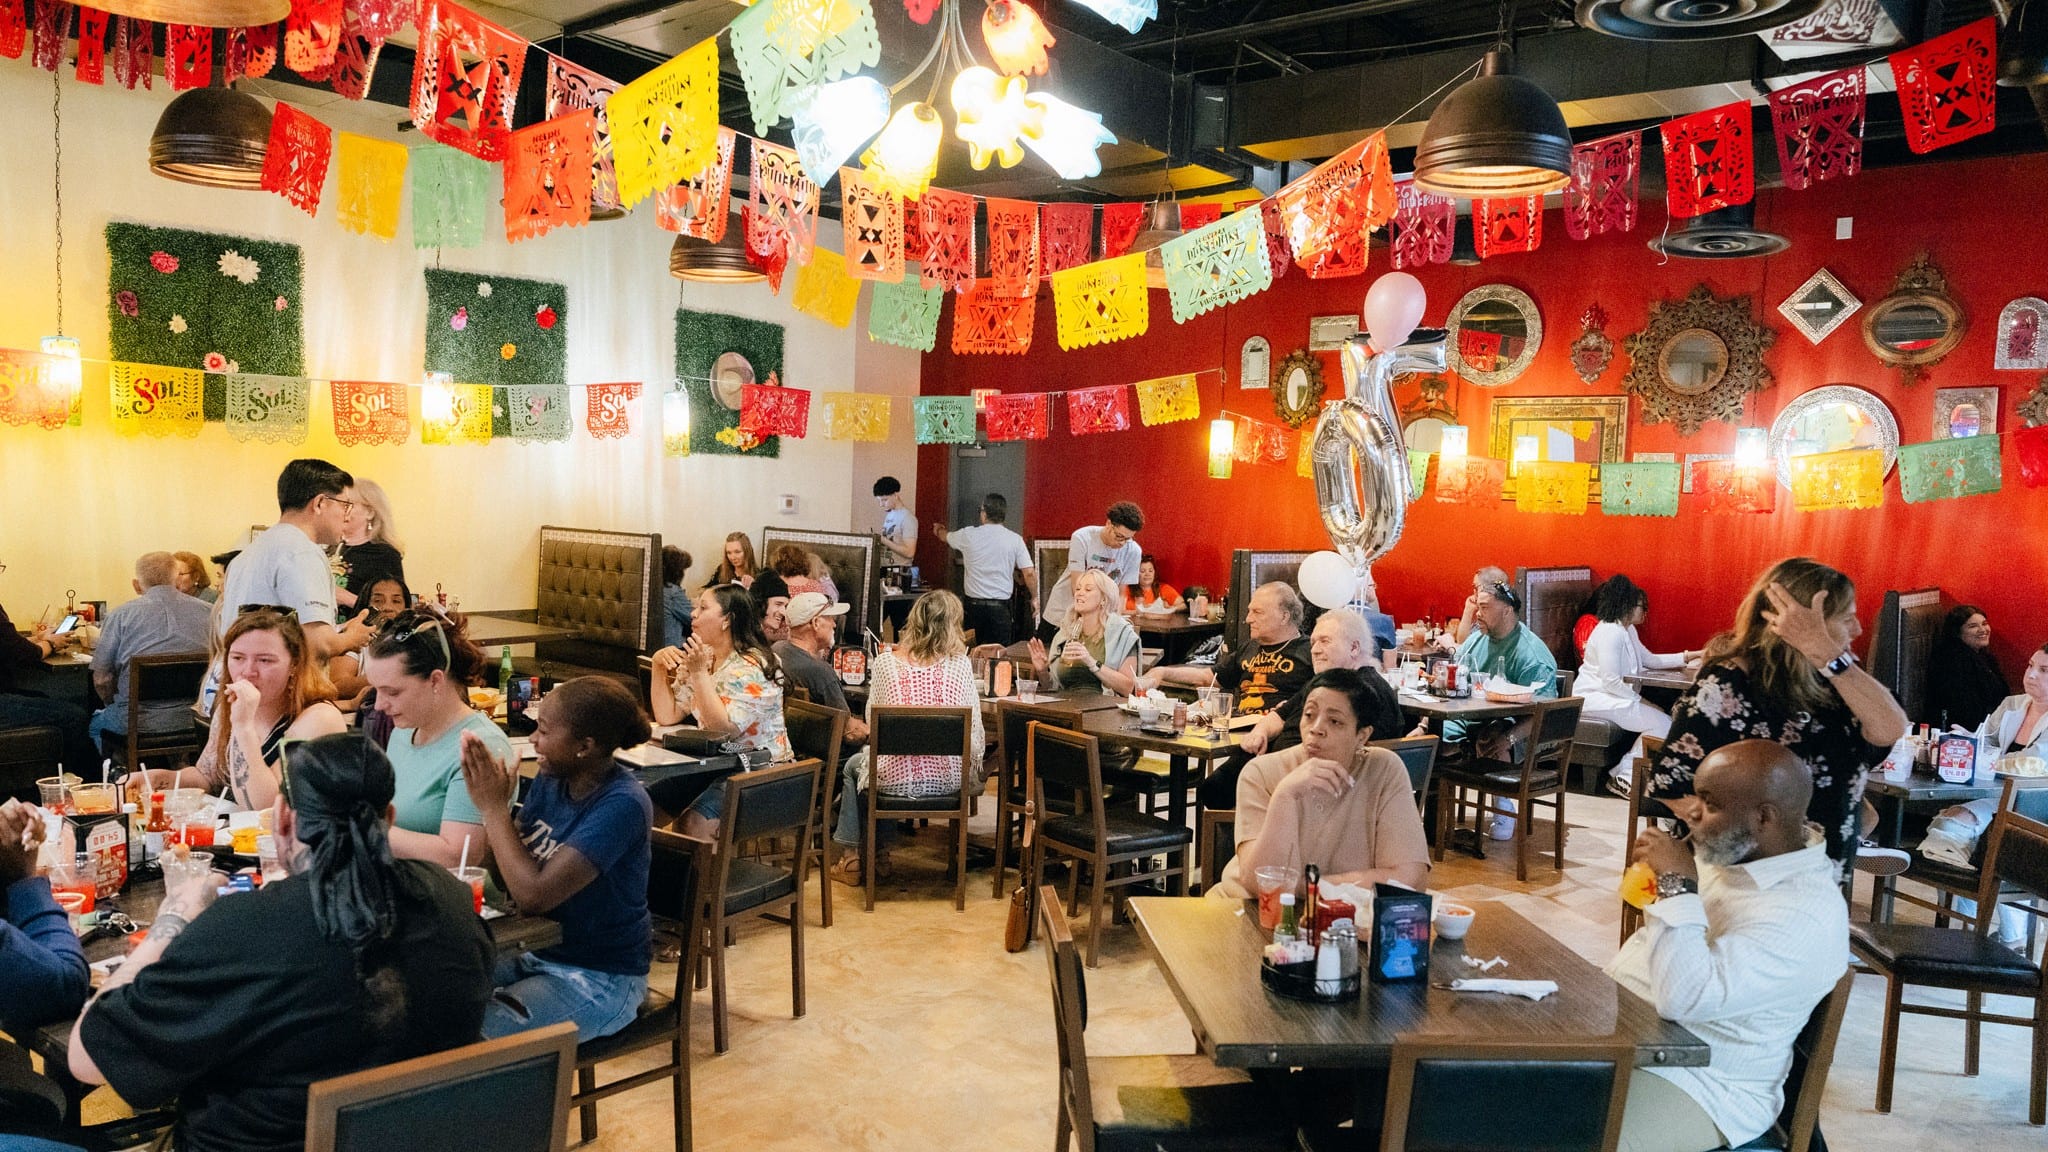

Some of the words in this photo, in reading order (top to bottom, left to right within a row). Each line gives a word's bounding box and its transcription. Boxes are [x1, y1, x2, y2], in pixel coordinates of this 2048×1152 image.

[131, 377, 182, 416] SOL
[245, 386, 294, 423] SOL
[350, 391, 391, 427] SOL
